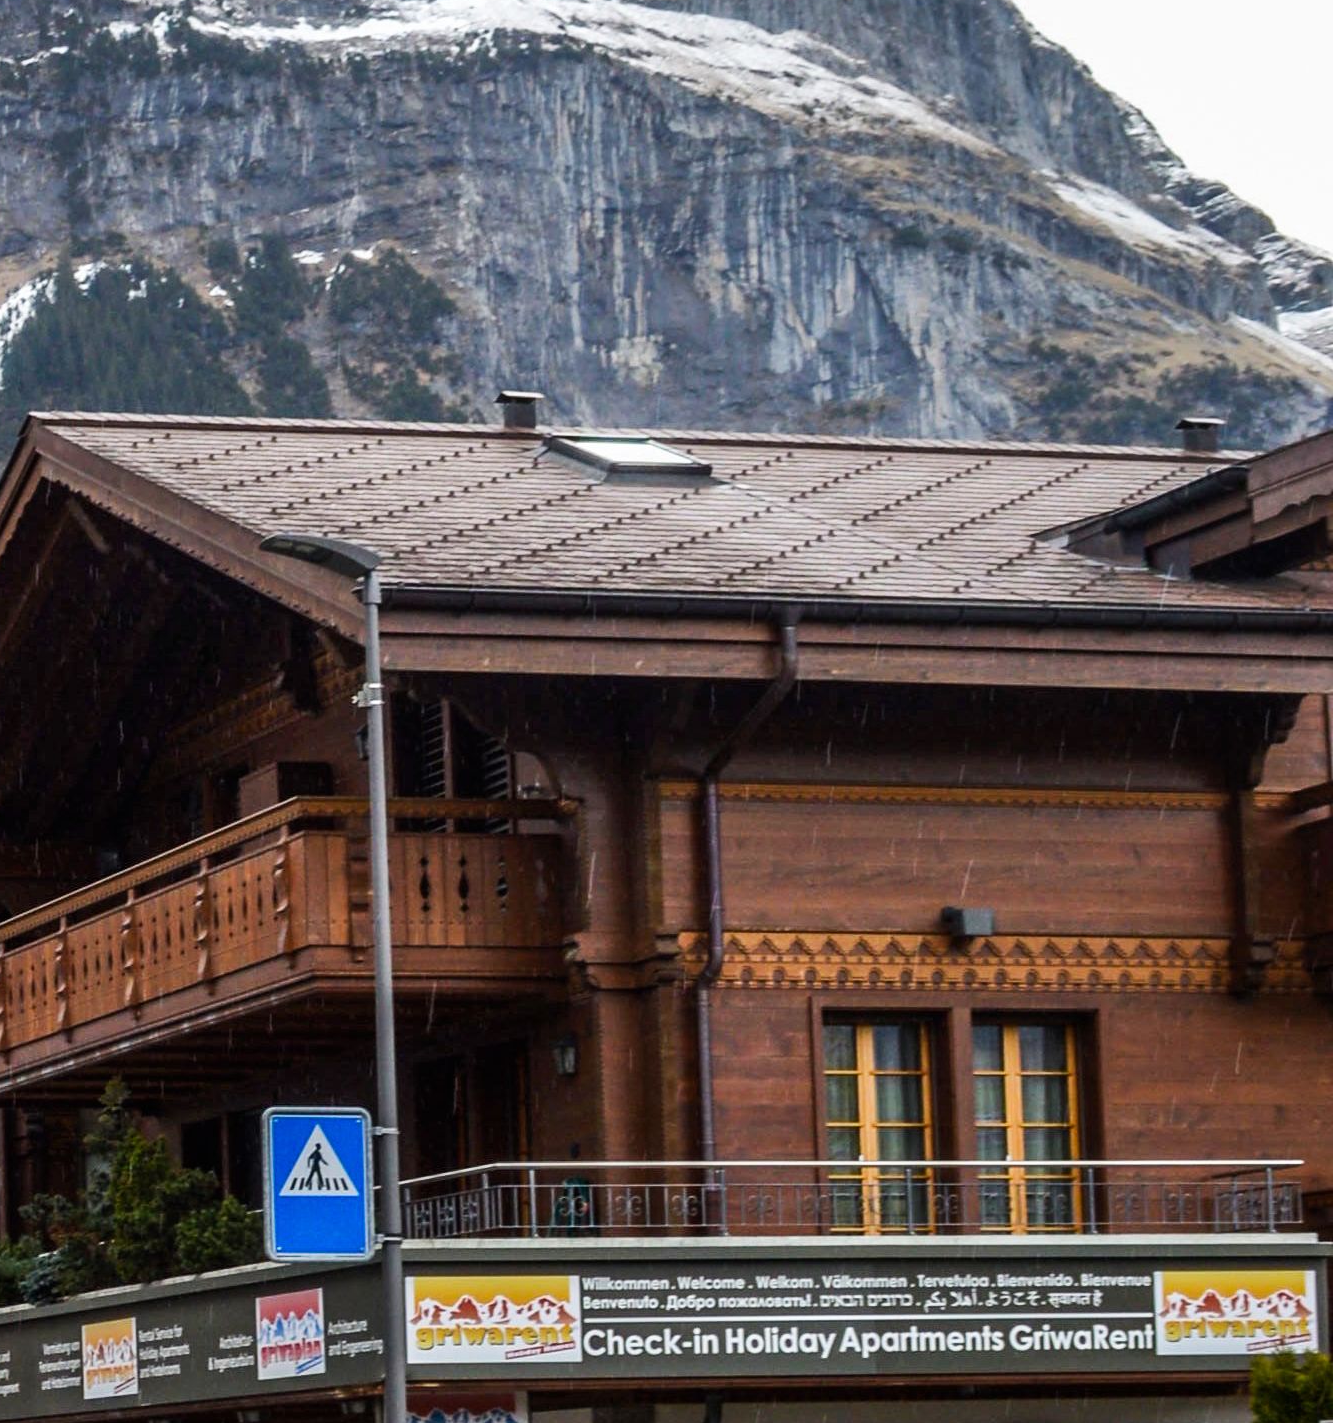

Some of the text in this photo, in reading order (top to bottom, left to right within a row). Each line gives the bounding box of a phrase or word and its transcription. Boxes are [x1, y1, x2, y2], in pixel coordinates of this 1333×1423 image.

[582, 1276, 669, 1290] Willkommen
[677, 1275, 745, 1290] Welcome
[755, 1275, 813, 1289] Welkom
[917, 1274, 989, 1288] Tervetuloa
[996, 1273, 1072, 1287] Bienvenido
[1080, 1273, 1152, 1287] Bienvenue
[582, 1296, 658, 1310] Benvenuto
[665, 1295, 715, 1312] Добро
[985, 1291, 1038, 1307] ようこそ
[415, 1323, 576, 1350] griwarent
[1164, 1315, 1311, 1343] griwarent
[583, 1323, 1154, 1359] Check-in Holiday Apartments GriwaRent
